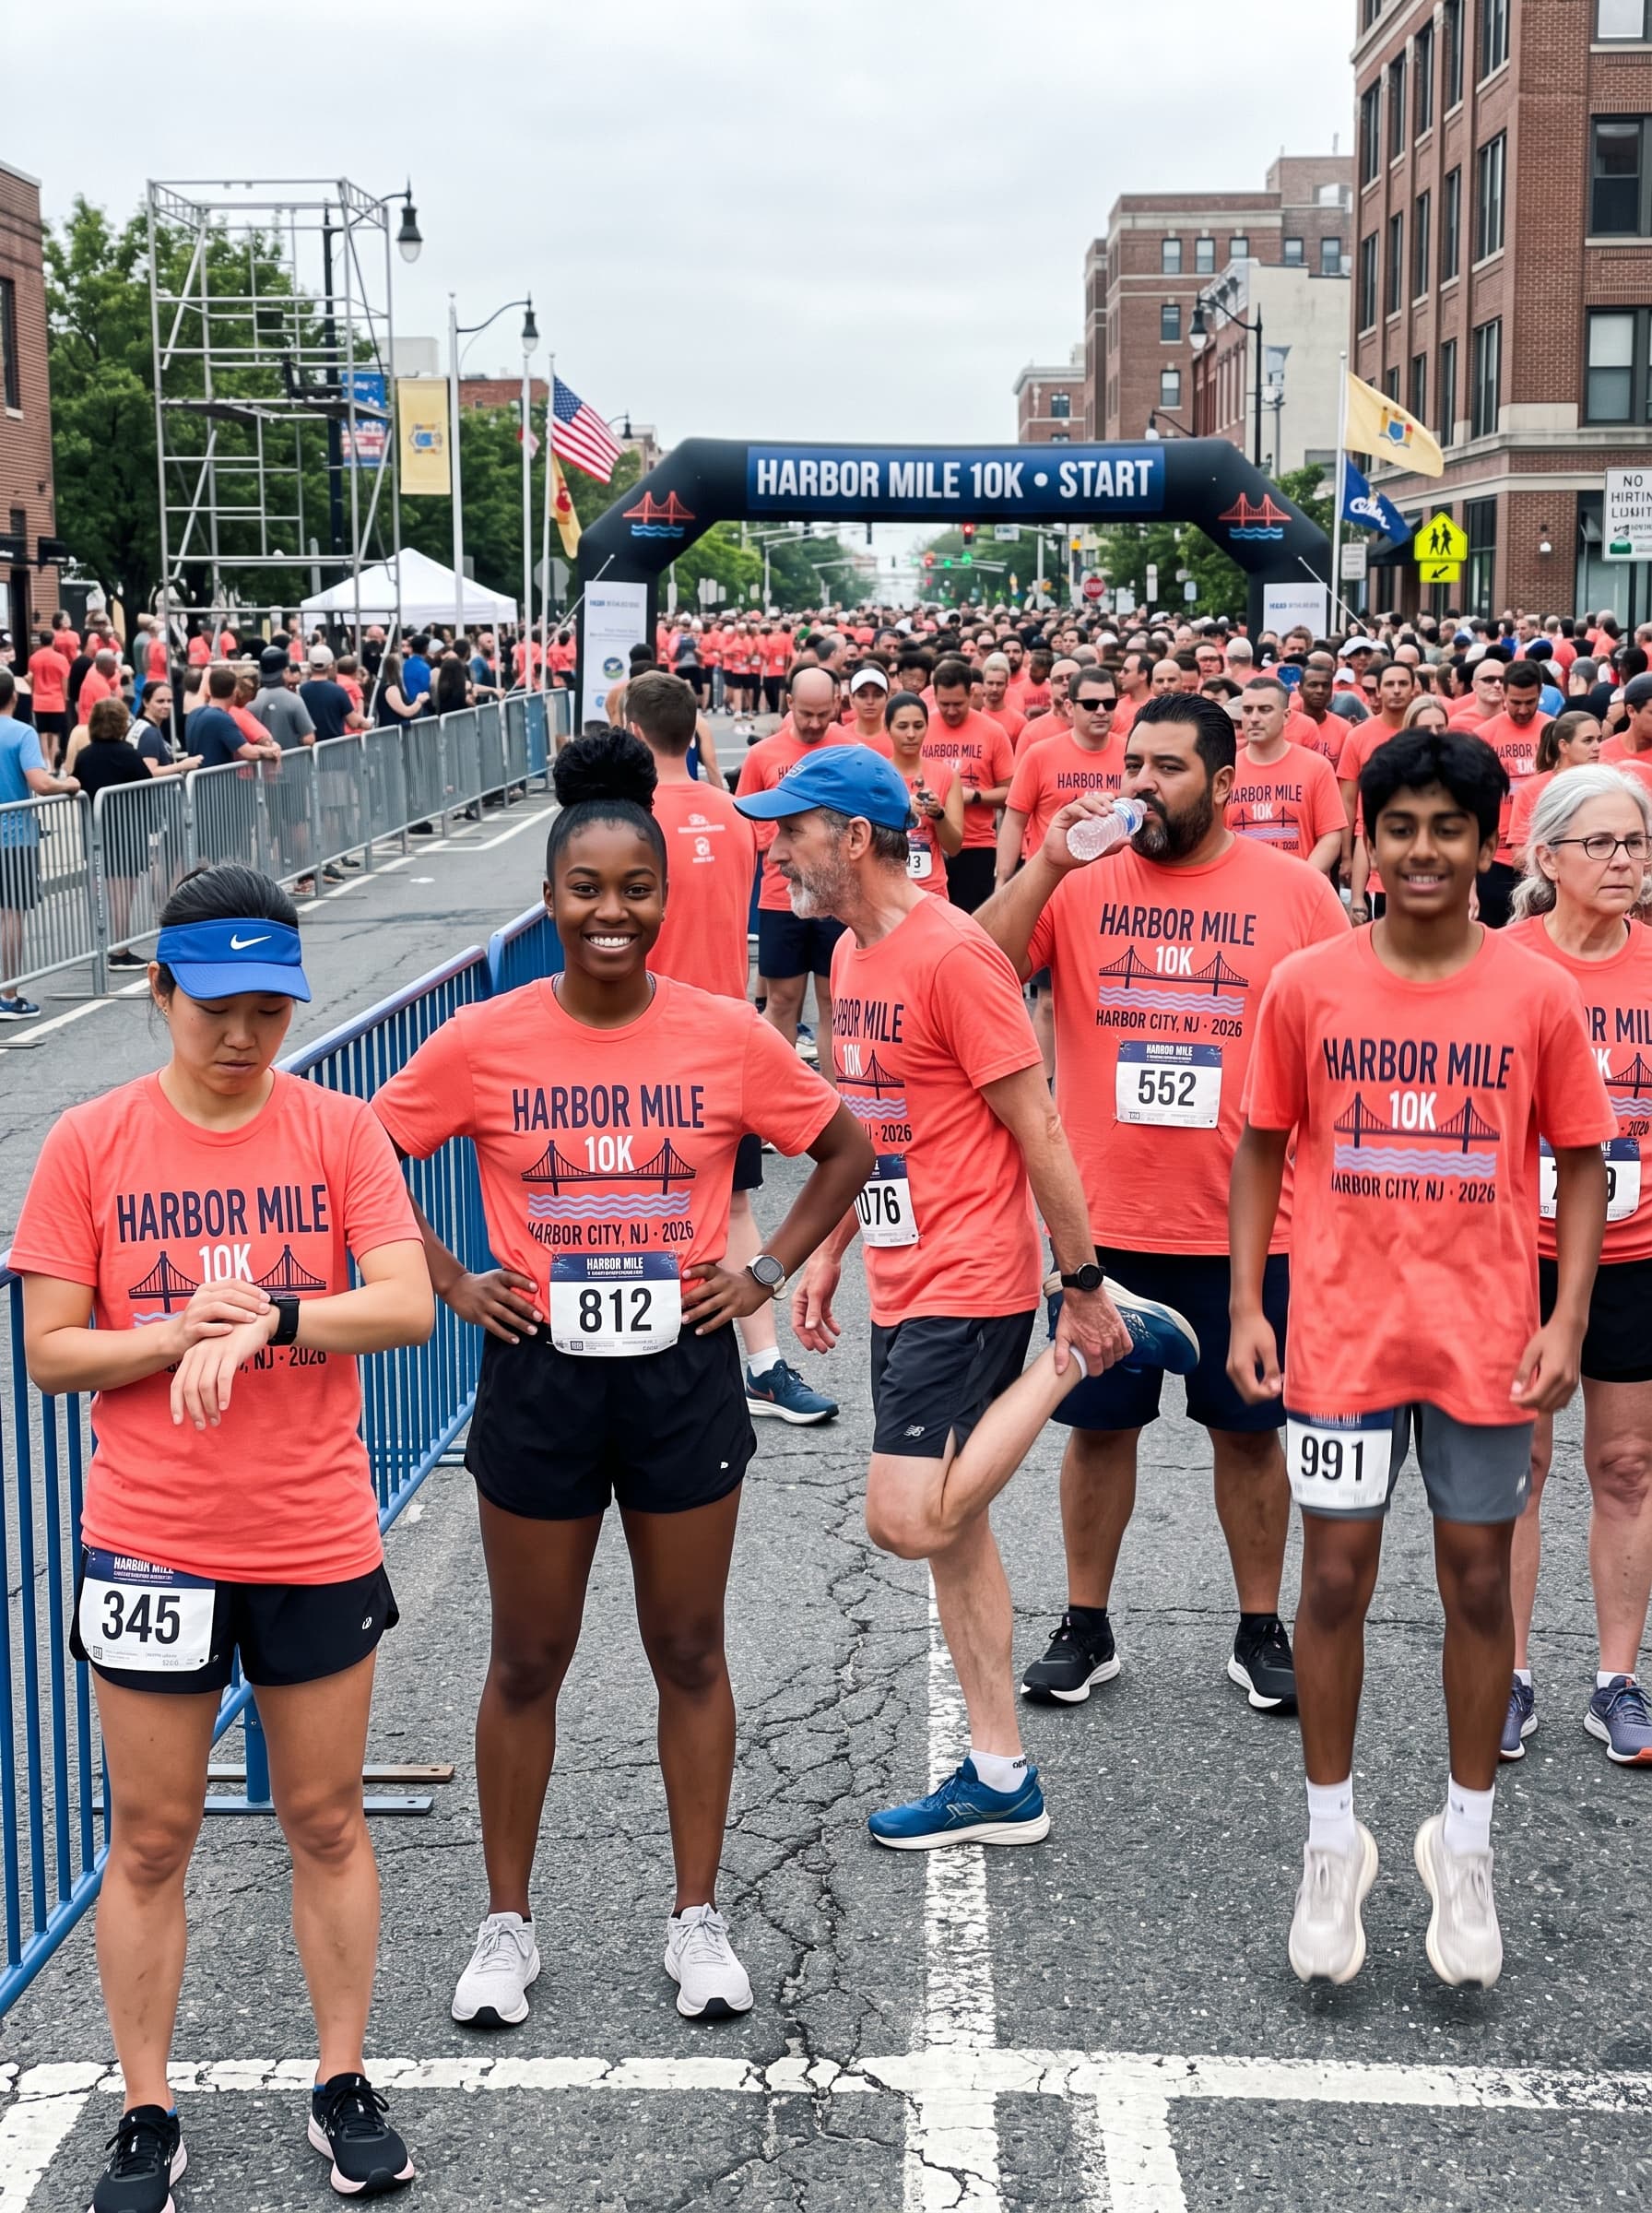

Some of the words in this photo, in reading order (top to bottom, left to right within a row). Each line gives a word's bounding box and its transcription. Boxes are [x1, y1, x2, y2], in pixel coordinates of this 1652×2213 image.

[757, 459, 879, 497] HARBOR
[888, 461, 962, 498] MILE
[970, 461, 1024, 498] 10K
[1059, 459, 1154, 498] START
[1623, 475, 1643, 487] NO
[922, 744, 958, 758] HARBOR
[962, 744, 983, 759] MILE
[1057, 773, 1103, 789] HARBOR
[1275, 785, 1302, 802] MILE
[1252, 803, 1273, 820] 10K
[1100, 903, 1195, 941] HARBOR
[1200, 910, 1257, 946] MILE
[1155, 945, 1195, 976] 10K
[863, 1000, 904, 1044] MILE
[1096, 1009, 1146, 1030] HARBOR
[1150, 1013, 1179, 1034] CITY,
[1184, 1016, 1200, 1033] NJ
[1210, 1018, 1243, 1037] 2026
[843, 1044, 864, 1077] 10K
[1175, 1046, 1194, 1057] MILE
[1323, 1037, 1438, 1085] HARBOR
[1447, 1041, 1515, 1090] MILE
[1138, 1069, 1197, 1107] 552
[513, 1084, 631, 1131] HARBOR
[640, 1084, 704, 1129] MILE
[1389, 1090, 1437, 1131] 10K
[880, 1123, 912, 1142] 2026
[584, 1135, 635, 1173] 10K
[1385, 1178, 1420, 1203] CITY,
[1425, 1180, 1445, 1201] NJ
[1458, 1182, 1496, 1203] 2026
[116, 1189, 248, 1243] HARBOR
[257, 1184, 329, 1234] MILE
[587, 1223, 625, 1247] CITY,
[630, 1223, 648, 1245] NJ
[662, 1220, 694, 1243] 2026
[198, 1243, 254, 1284] 10K
[586, 1257, 621, 1271] HARBOR
[623, 1257, 643, 1270] MILE
[579, 1287, 652, 1333] 812
[254, 1347, 274, 1370] NJ
[1301, 1436, 1363, 1482] 991
[101, 1590, 181, 1645] 345
